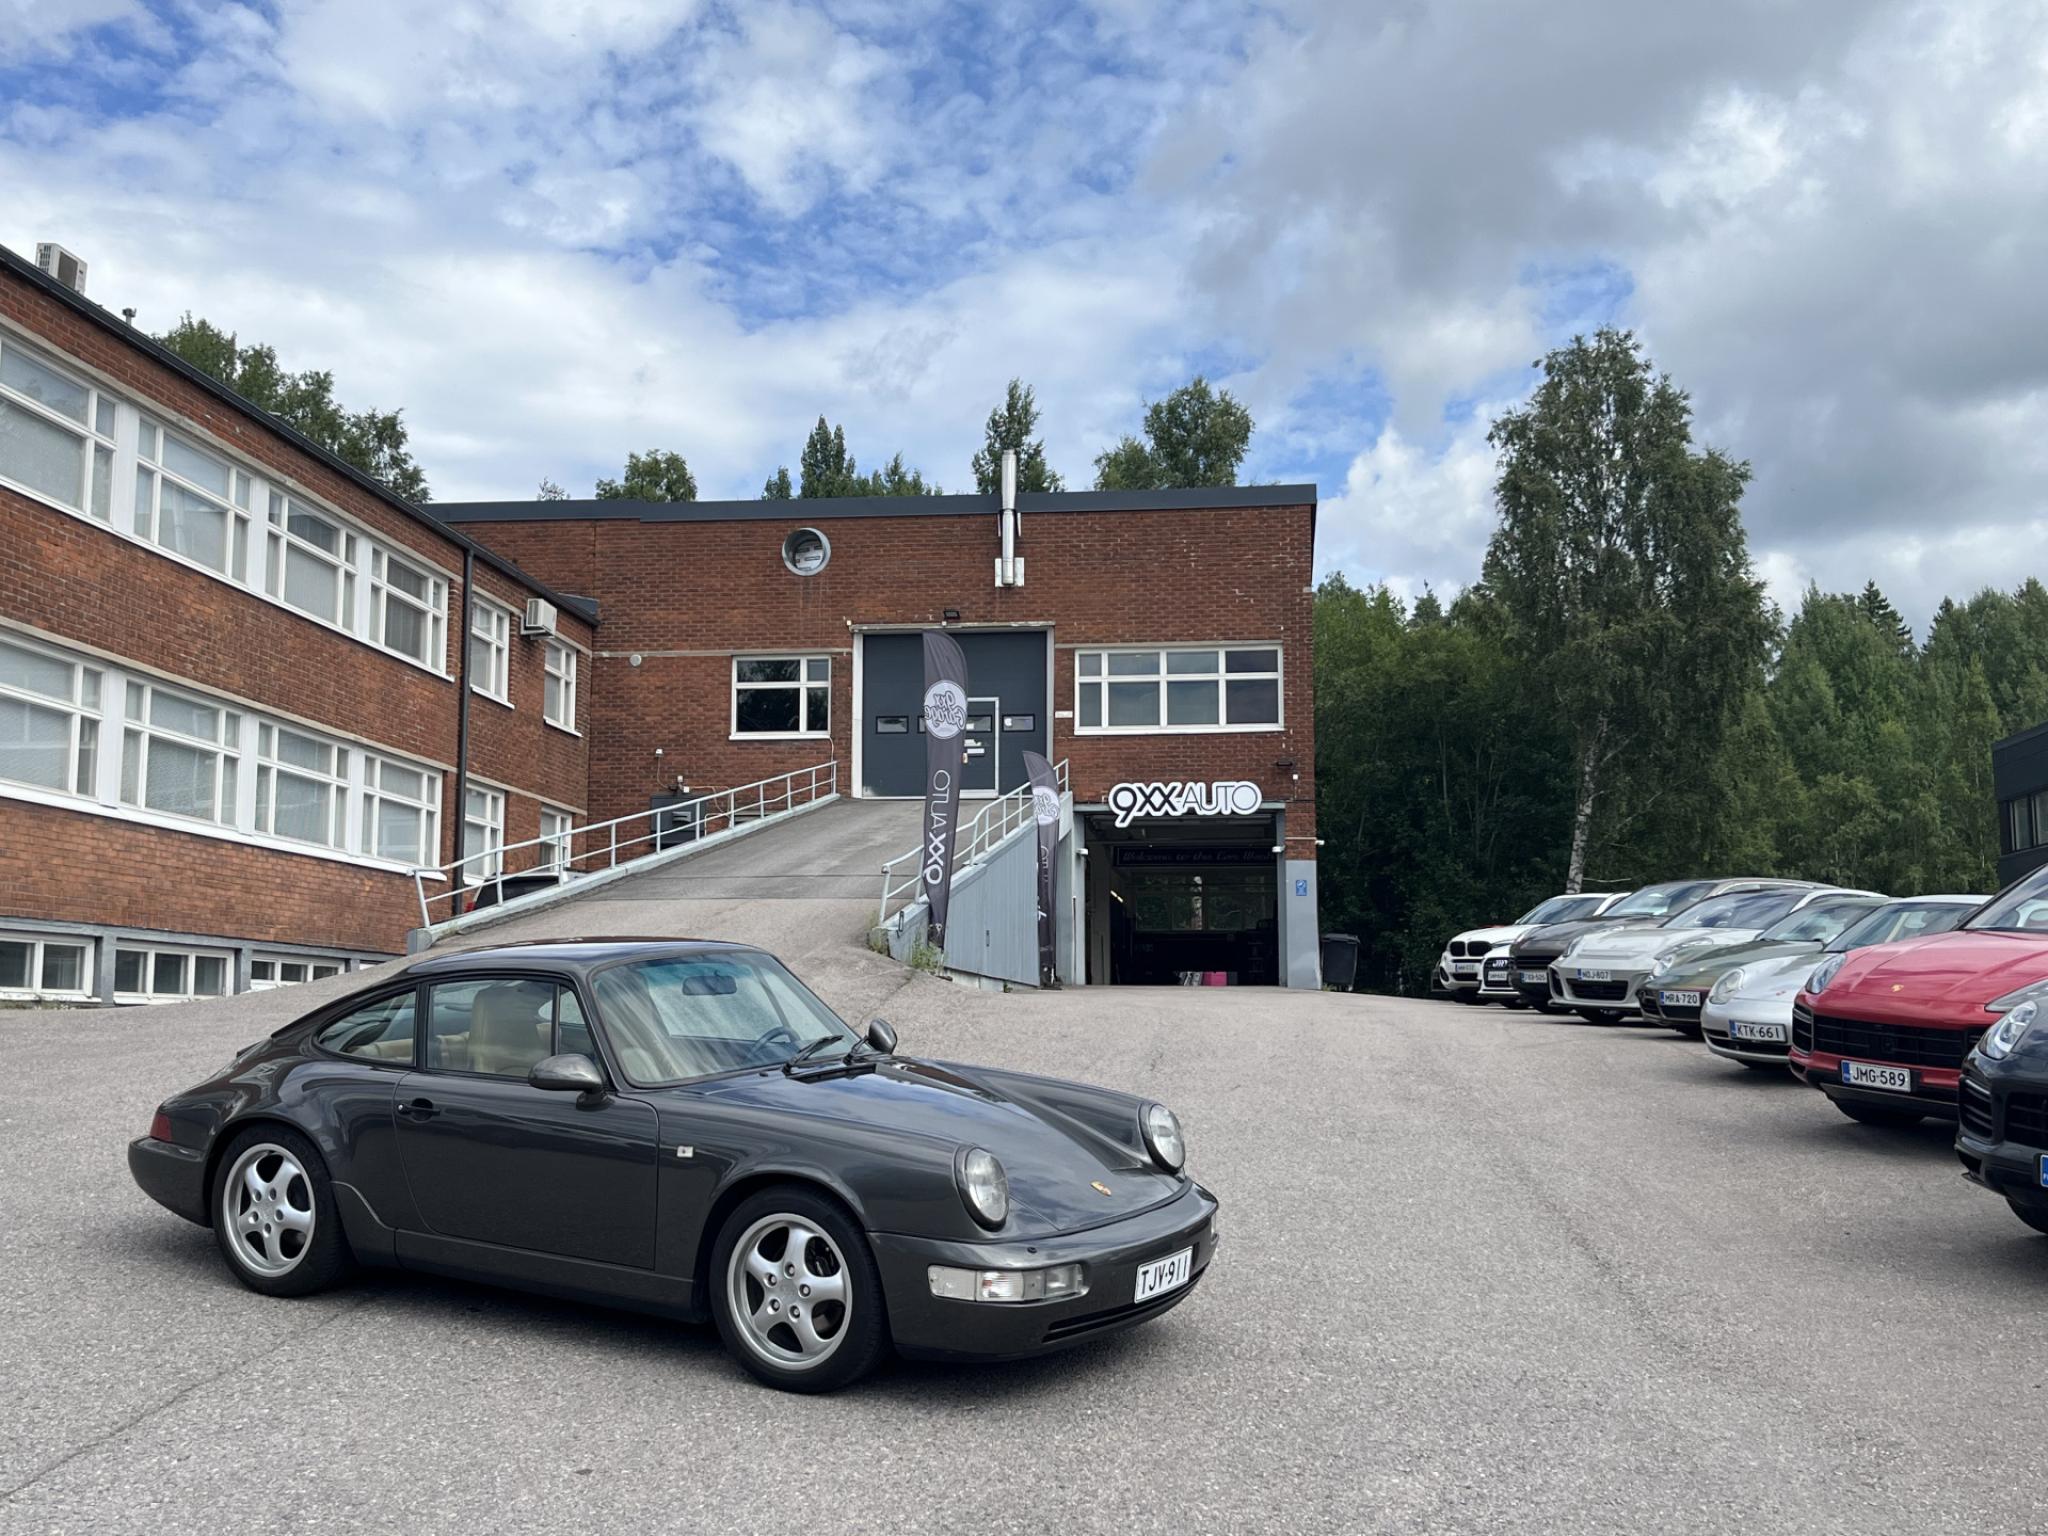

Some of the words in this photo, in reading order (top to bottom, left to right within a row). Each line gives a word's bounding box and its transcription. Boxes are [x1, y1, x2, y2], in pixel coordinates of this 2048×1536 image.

[1665, 993, 1698, 1005] MRA-720
[1737, 1024, 1780, 1039] KTK-661
[1853, 1065, 1906, 1087] JMG-589
[1141, 1254, 1188, 1295] TJV-911
